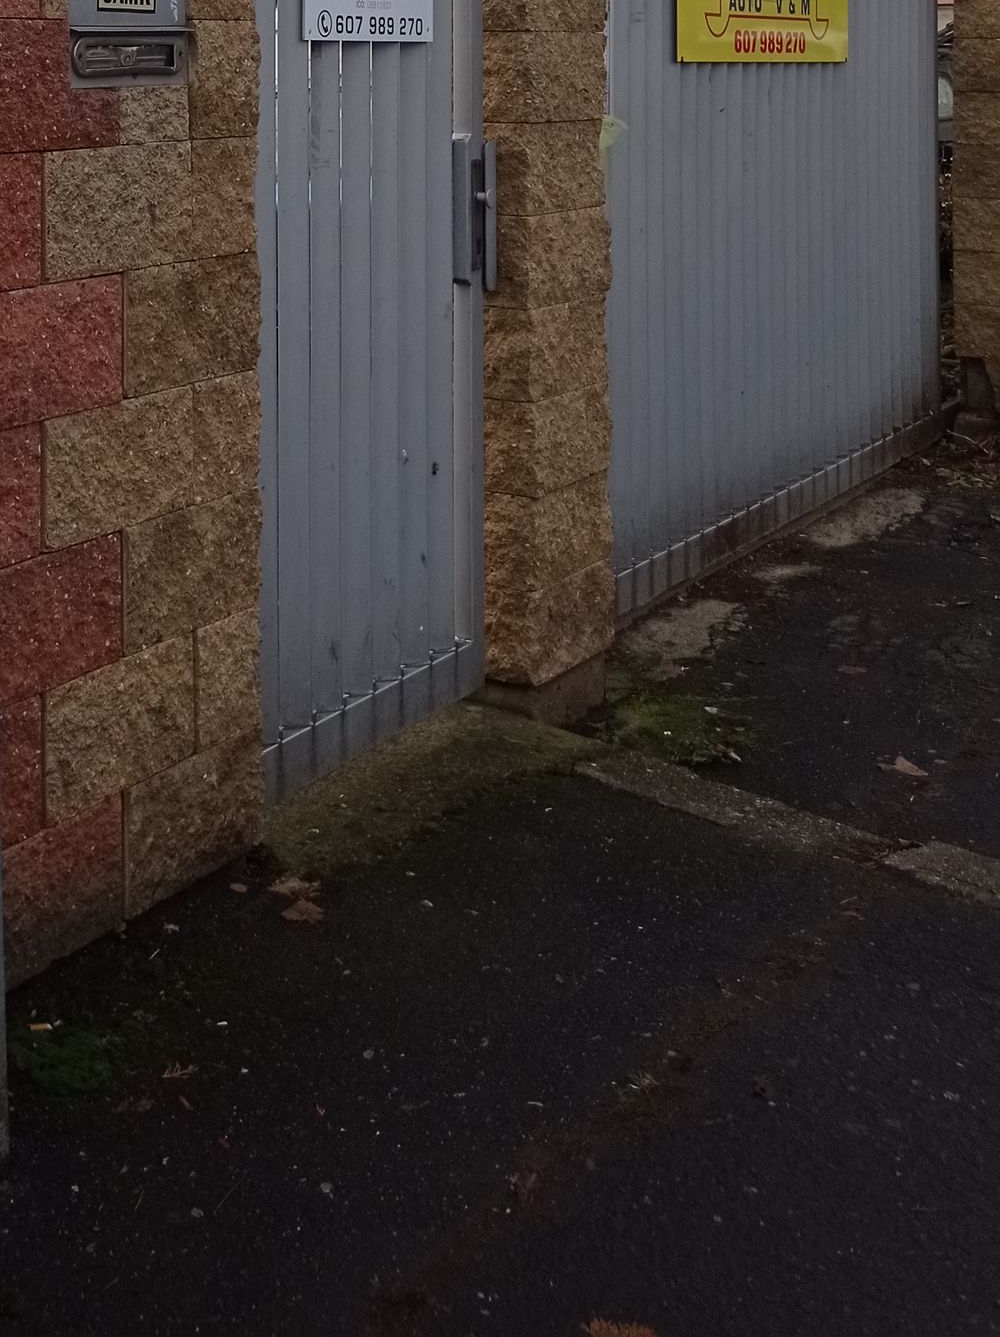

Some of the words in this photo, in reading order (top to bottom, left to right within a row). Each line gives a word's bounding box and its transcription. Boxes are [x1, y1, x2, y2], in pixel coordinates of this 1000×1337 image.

[335, 14, 363, 35] 607
[369, 16, 394, 35] 989
[399, 17, 423, 36] 270
[734, 29, 758, 53] 607
[760, 30, 783, 54] 989
[785, 31, 806, 54] 270
